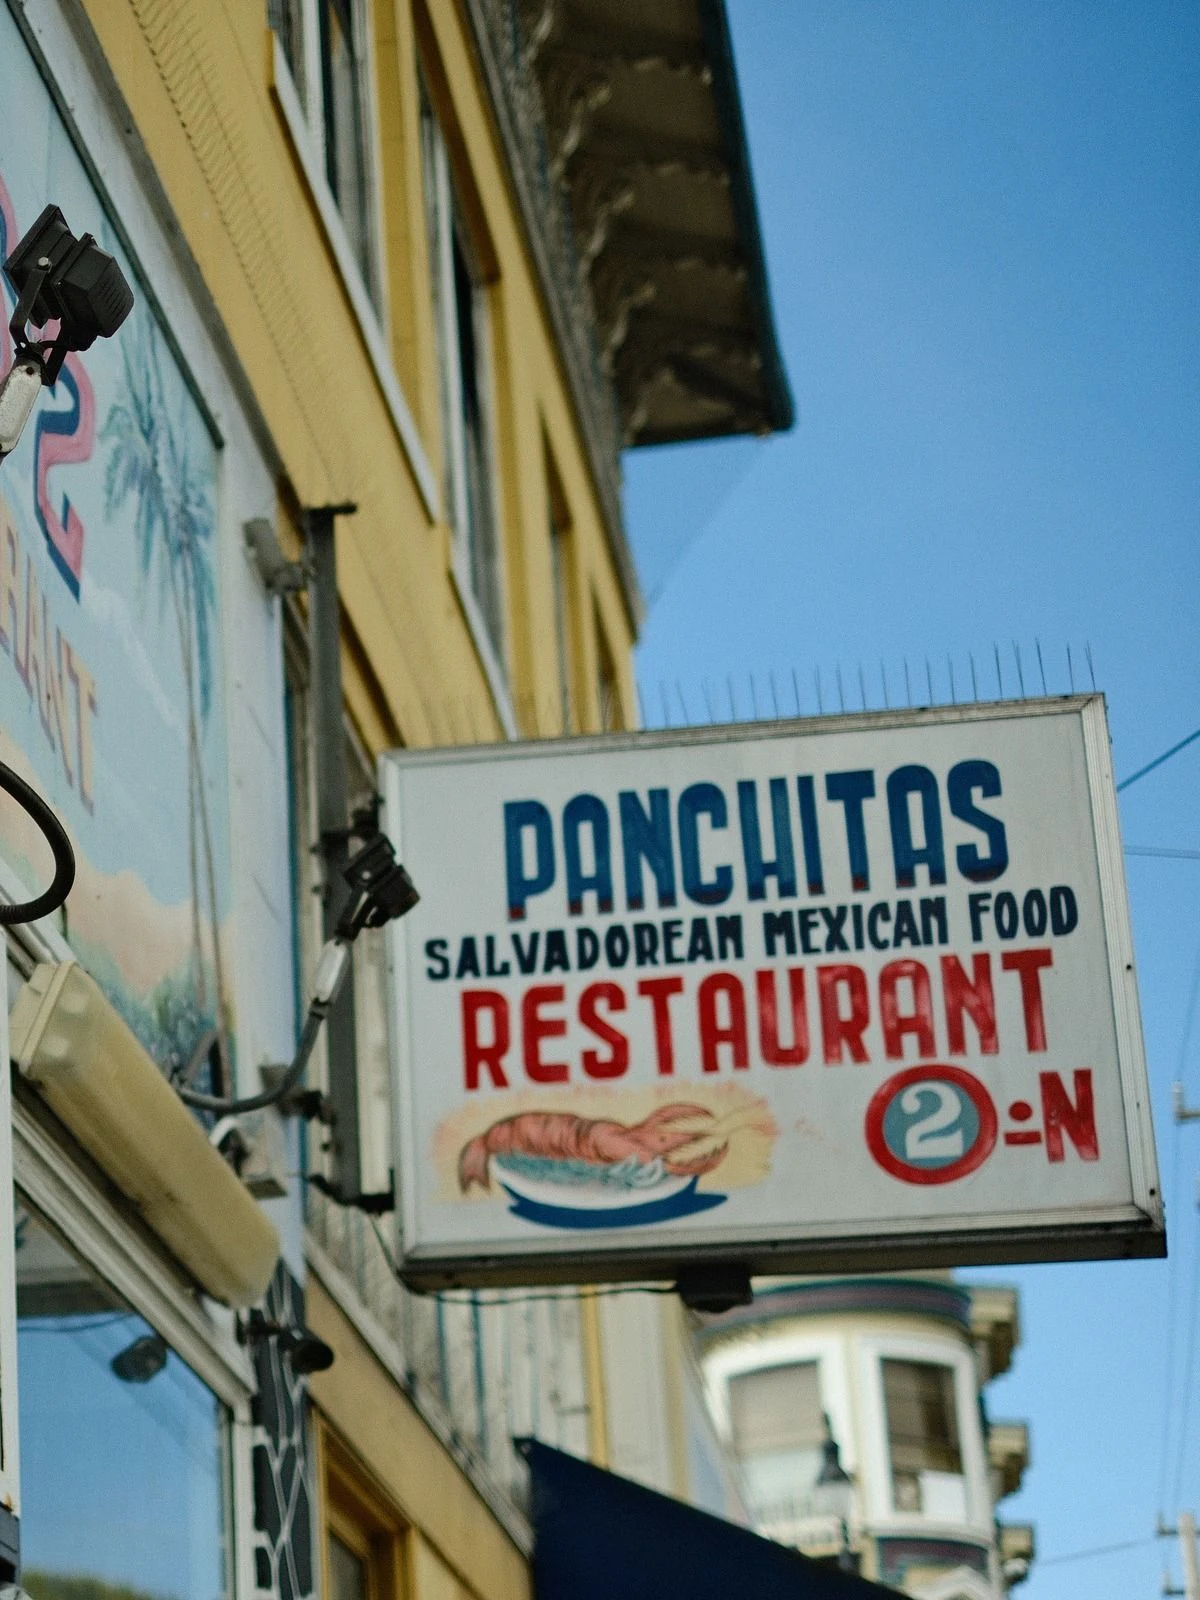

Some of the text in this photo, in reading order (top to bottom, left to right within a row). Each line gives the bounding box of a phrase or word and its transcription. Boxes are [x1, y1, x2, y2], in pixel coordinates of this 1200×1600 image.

[502, 759, 1010, 922] PANCHITAS
[424, 885, 1080, 981] SALVADOREAN MEXICAN FOOD
[459, 948, 1056, 1092] RESTAURANT
